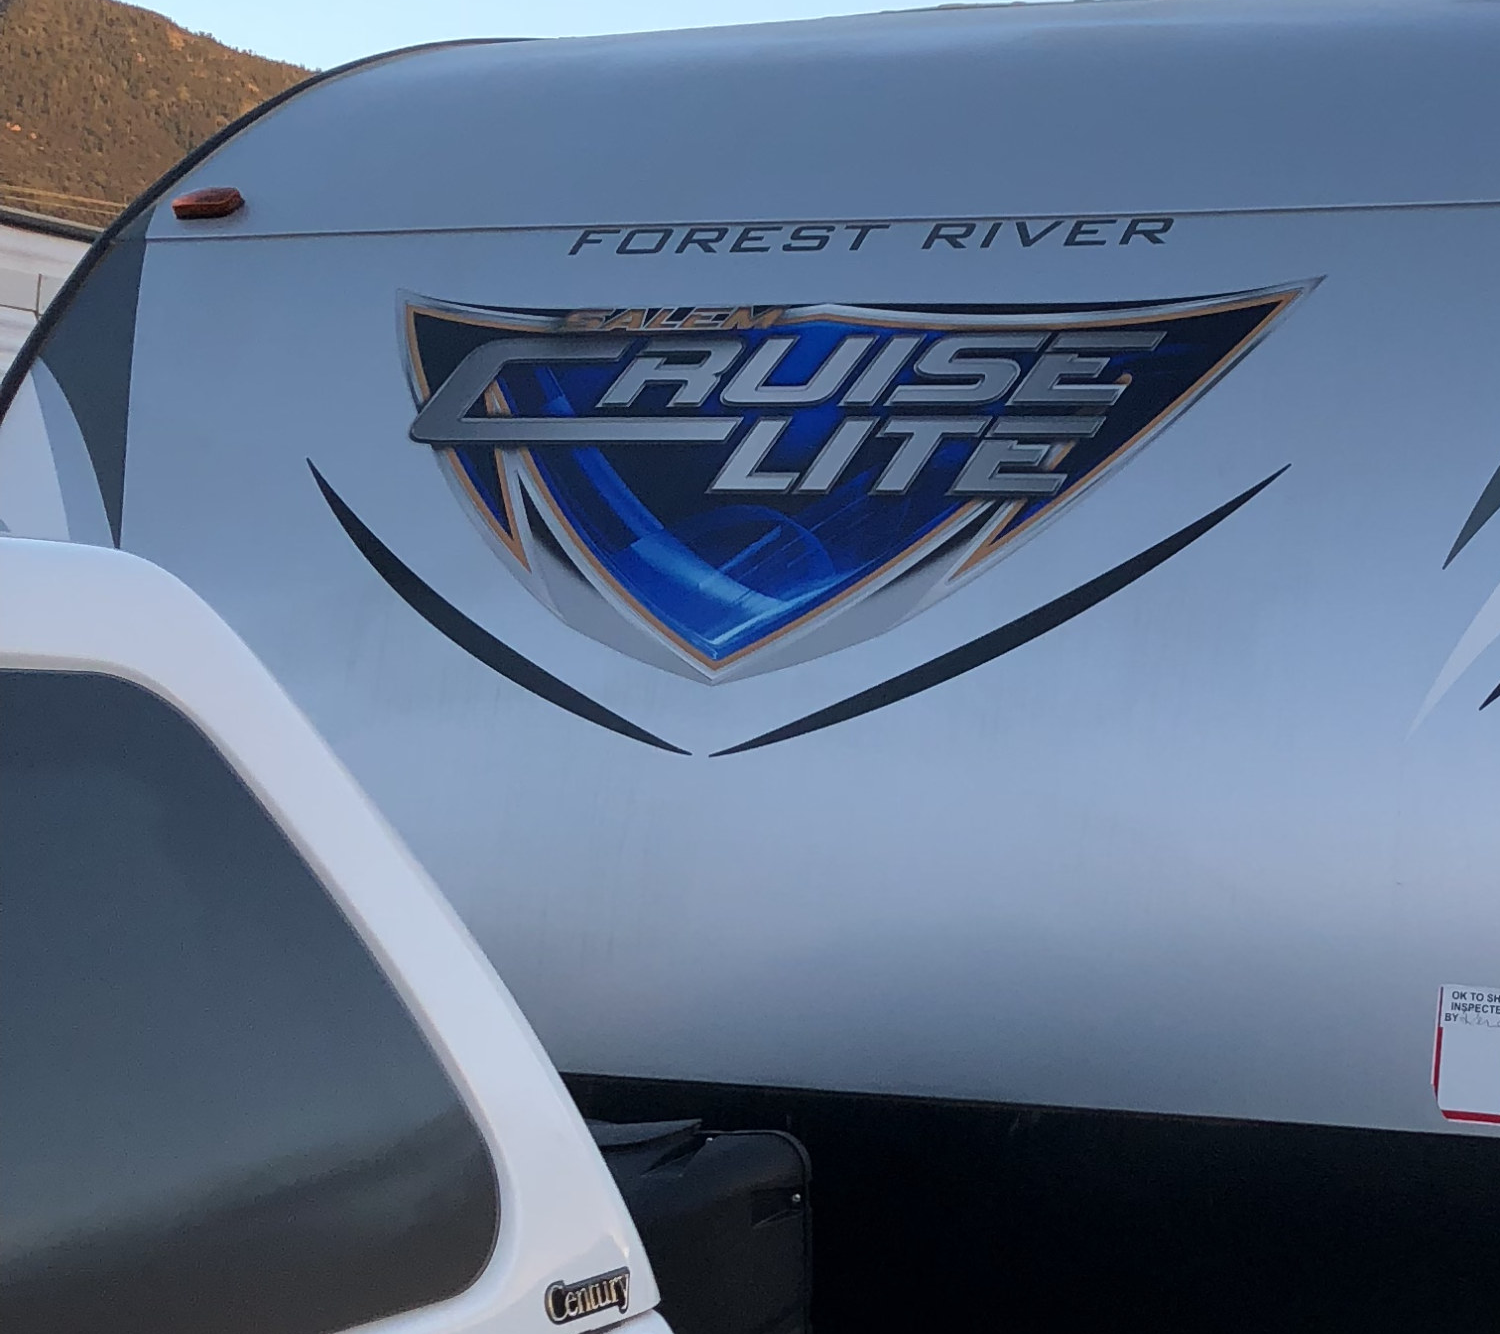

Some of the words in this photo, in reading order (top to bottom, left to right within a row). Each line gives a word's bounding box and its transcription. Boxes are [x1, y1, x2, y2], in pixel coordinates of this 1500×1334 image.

[567, 223, 891, 256] FOREST
[920, 217, 1175, 250] RIVER
[564, 304, 792, 333] SALEM
[408, 330, 1168, 445] CRUISE
[704, 414, 1108, 496] LITE
[1451, 990, 1467, 1000] OK
[1470, 992, 1485, 1002] TO
[1444, 1012, 1459, 1022] BY
[547, 1272, 630, 1323] Century
